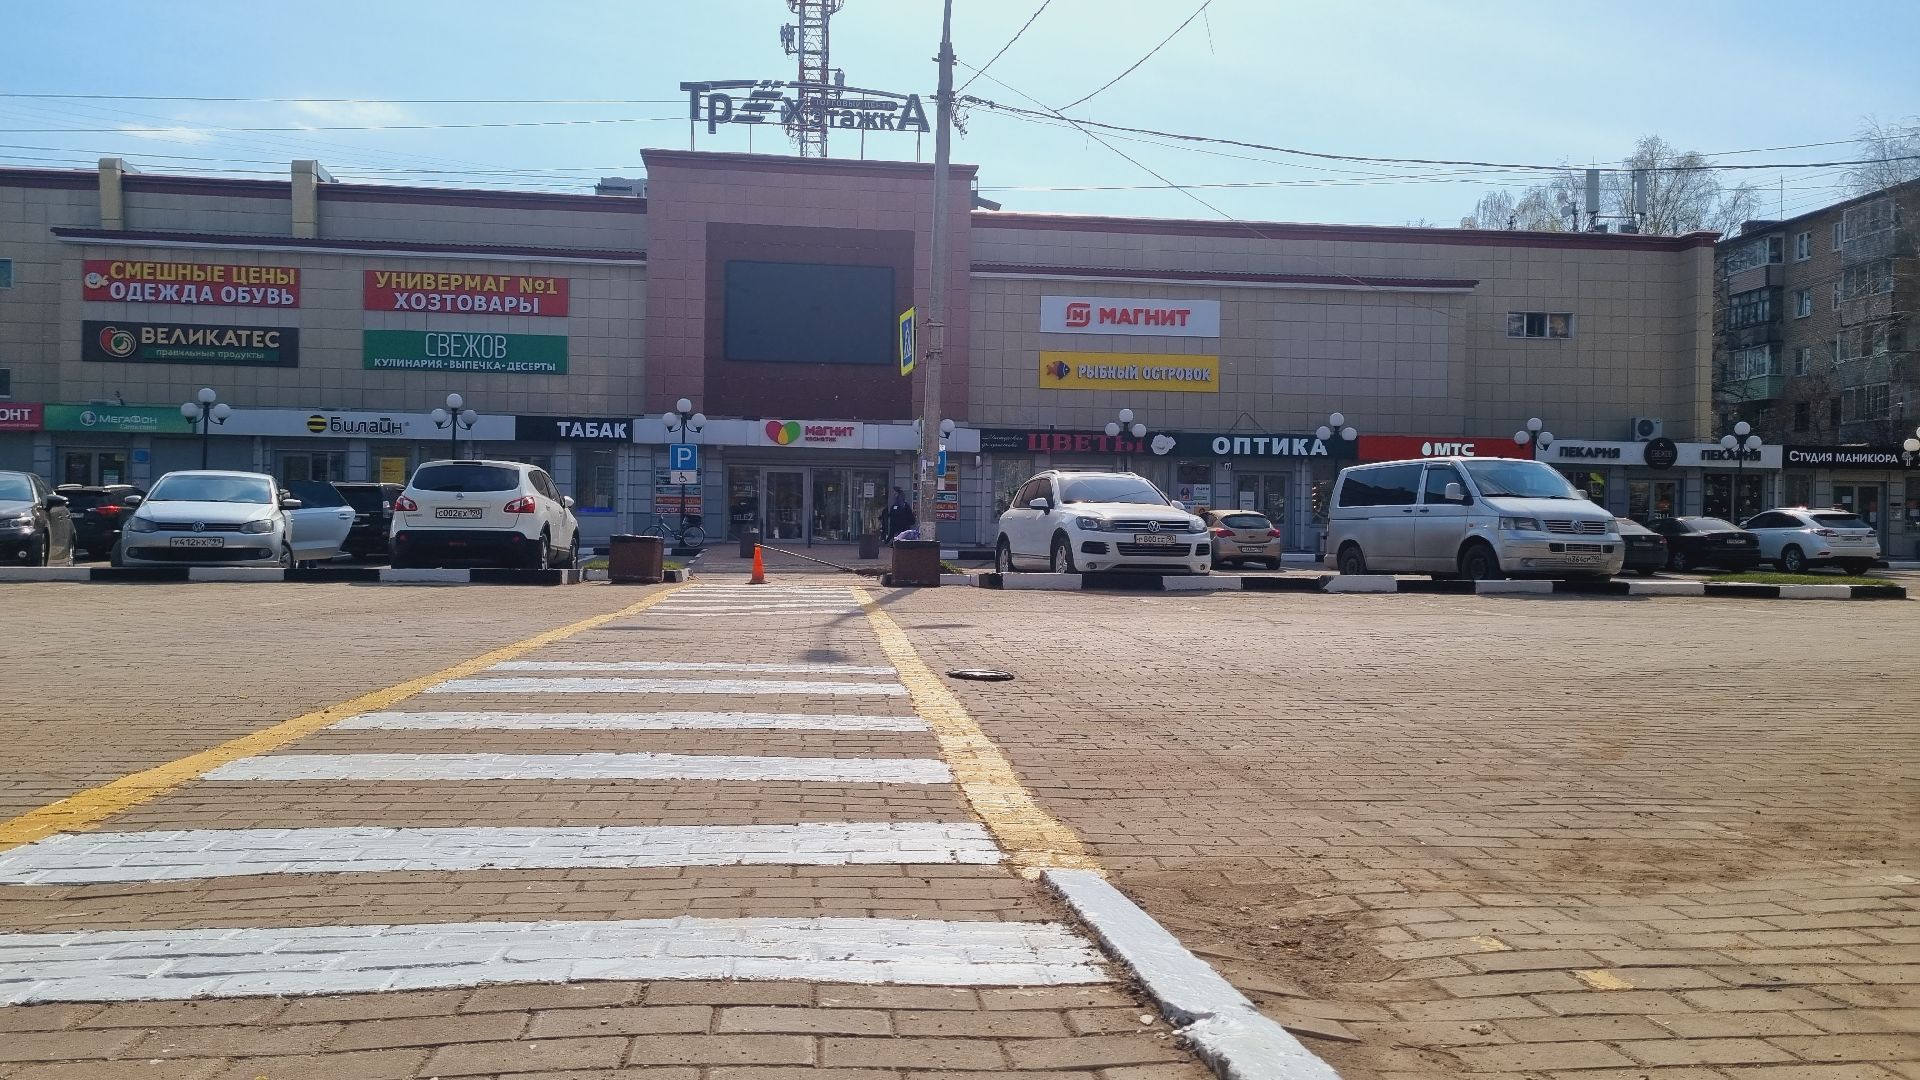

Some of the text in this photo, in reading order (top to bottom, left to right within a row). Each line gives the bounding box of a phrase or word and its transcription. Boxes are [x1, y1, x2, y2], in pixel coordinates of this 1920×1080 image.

[110, 262, 295, 285] СМЕШНЫЕ ЦЕНЫ
[375, 271, 558, 295] УНИВЕРМАГ №1
[110, 282, 294, 305] ОДЕЖДА ОБУВЬ
[394, 292, 539, 314] ХОЗТОВАРЫ
[1099, 307, 1191, 327] МАГНИТ
[141, 326, 280, 348] ВЕЛИКАТЕС
[425, 332, 507, 359] СВЕЖОВ
[156, 350, 264, 360] правильные продукты
[374, 358, 556, 371] КУЛИНАРИЯ ВЫПЕЧКА ДЕСЕРТЫ
[1077, 364, 1212, 382] РЫБНЫЙ ОСТРОВОК
[330, 416, 402, 434] Билайн
[556, 421, 627, 439] ТАБАК
[1027, 433, 1145, 453] ЦВЕТЫ
[1212, 436, 1328, 456] ОПТИКА
[1434, 442, 1475, 456] МТС
[1559, 446, 1620, 459] ПЕКАРНЯ
